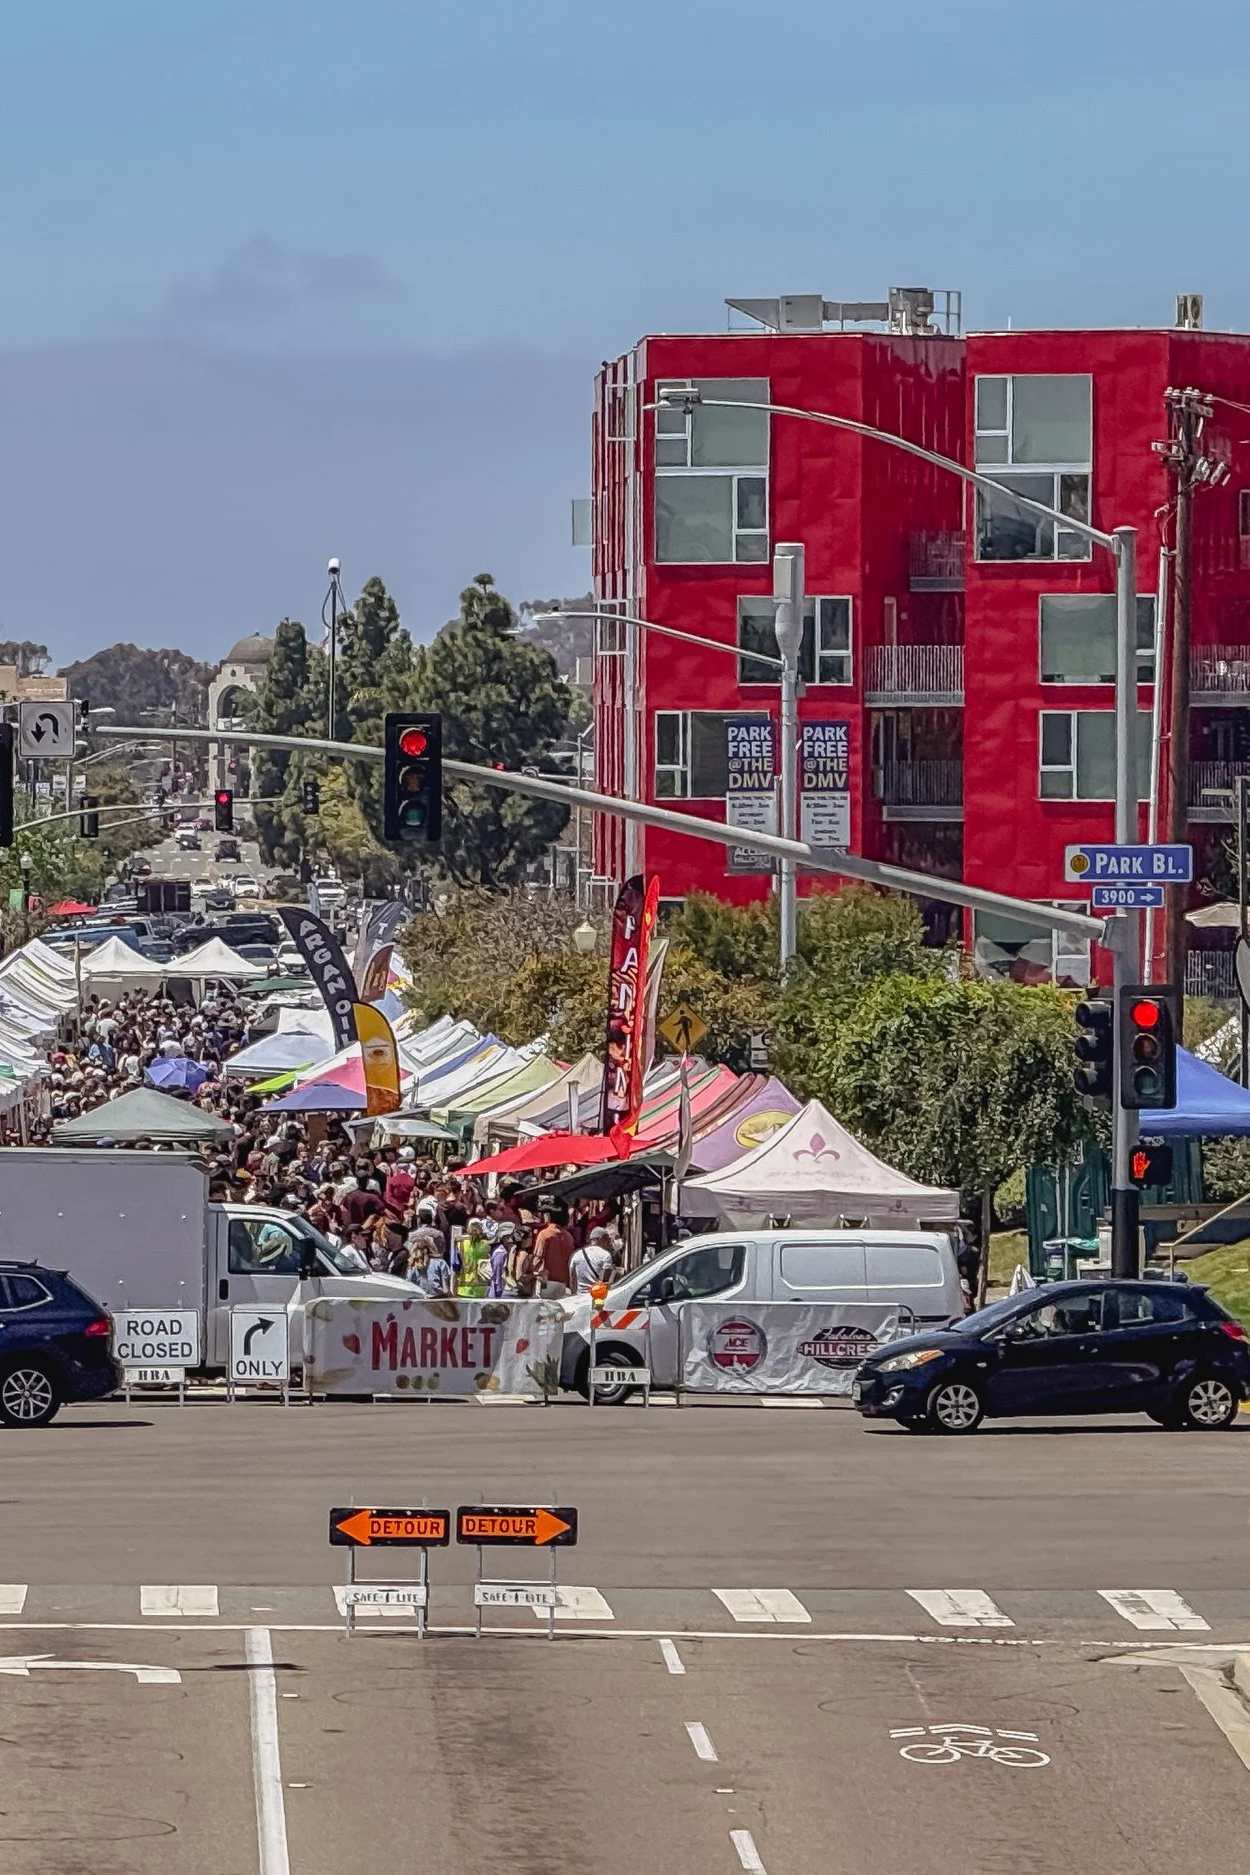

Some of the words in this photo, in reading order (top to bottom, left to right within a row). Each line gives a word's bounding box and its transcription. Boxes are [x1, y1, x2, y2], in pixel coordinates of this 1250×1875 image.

[727, 726, 772, 741] PARK
[803, 726, 847, 741] PARK
[728, 741, 773, 758] FREE
[803, 741, 848, 758] FREE
[728, 758, 773, 772] @THE
[803, 758, 848, 772] @THE
[728, 773, 772, 789] DMV
[803, 773, 847, 789] DMV
[1101, 890, 1135, 904] 3900
[299, 920, 347, 995] ARGAN
[126, 1319, 183, 1336] ROAD
[117, 1342, 193, 1359] CLOSED
[371, 1321, 497, 1371] MARKET
[235, 1360, 283, 1376] ONLY
[370, 1520, 440, 1535] DETOUR
[465, 1518, 536, 1534] DETOUR
